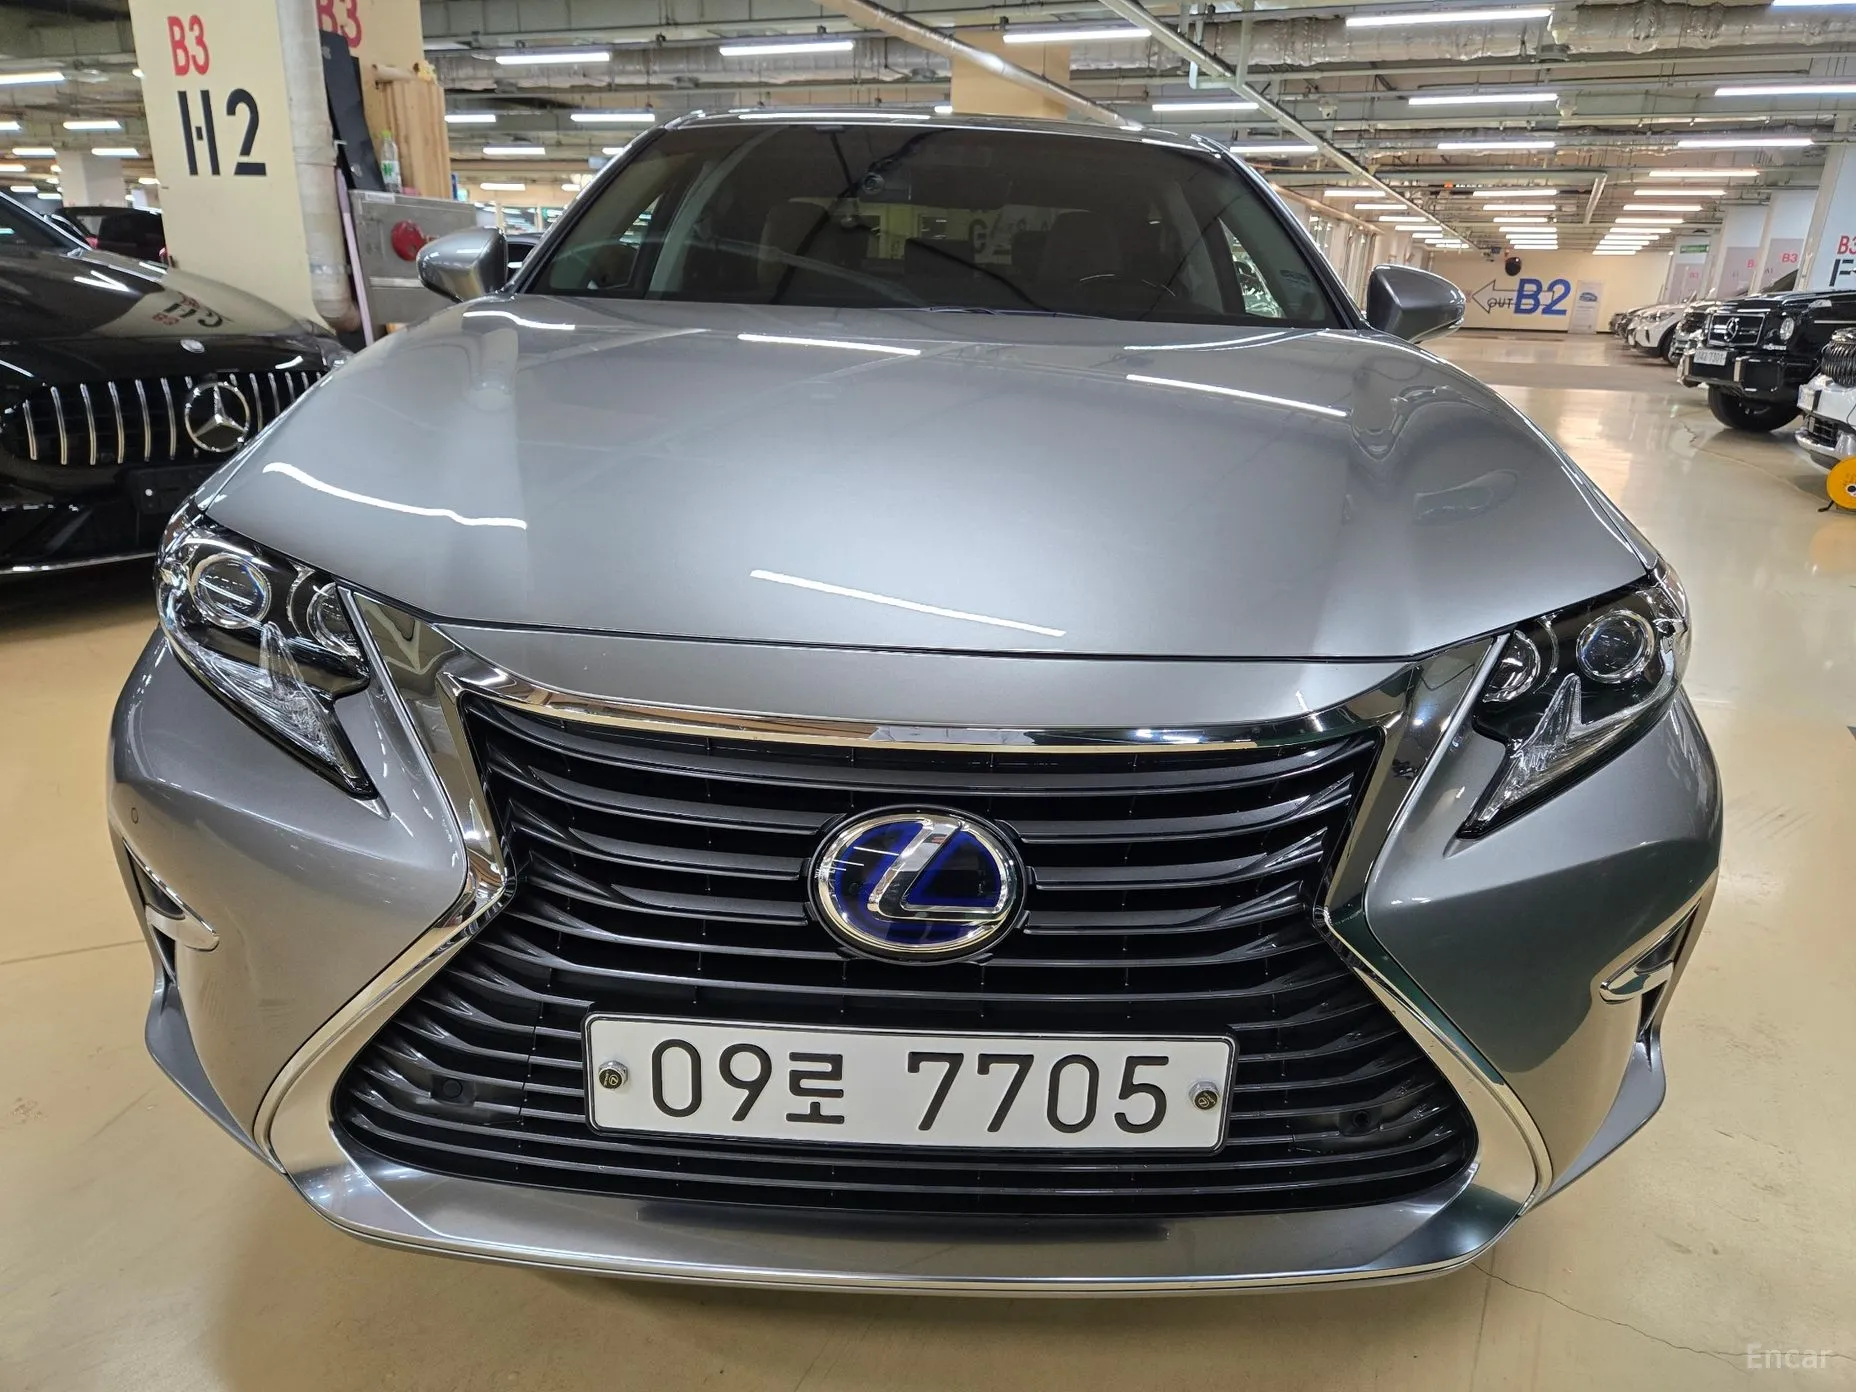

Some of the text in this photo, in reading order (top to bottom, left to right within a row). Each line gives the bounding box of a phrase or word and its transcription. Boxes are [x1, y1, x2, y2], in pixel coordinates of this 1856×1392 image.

[167, 15, 210, 76] B3
[177, 88, 267, 176] H2
[1782, 253, 1798, 263] B3
[1513, 278, 1571, 316] B2
[651, 1038, 1170, 1135] 09로 7705
